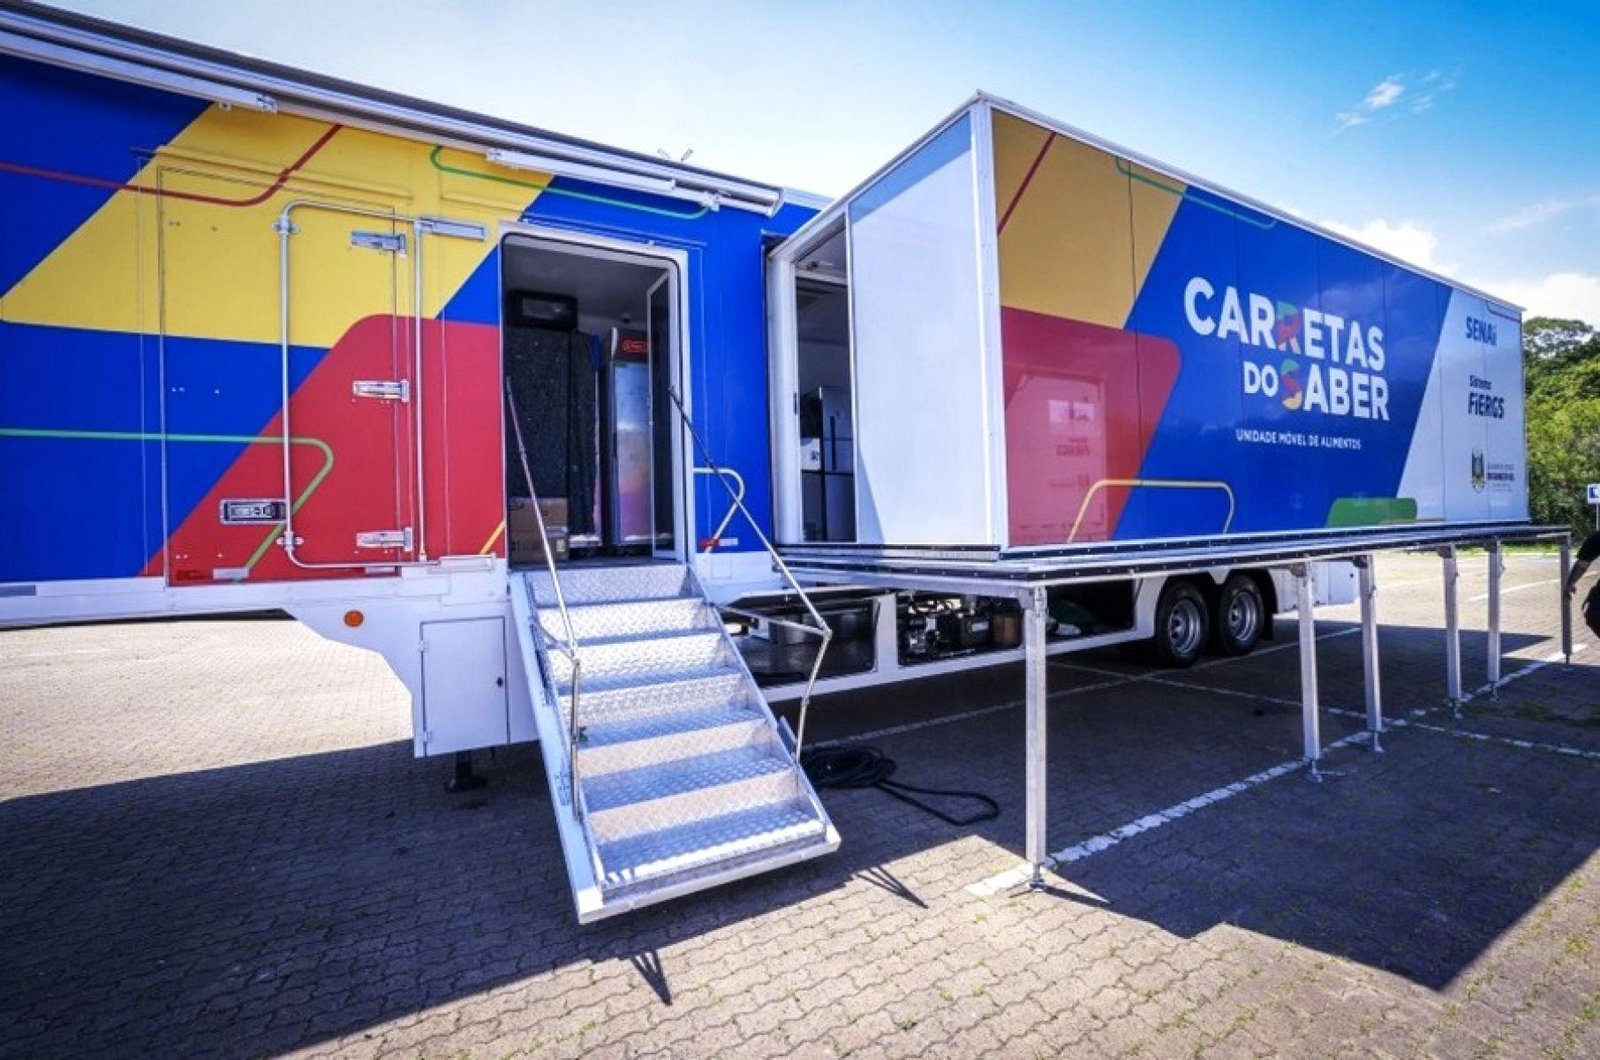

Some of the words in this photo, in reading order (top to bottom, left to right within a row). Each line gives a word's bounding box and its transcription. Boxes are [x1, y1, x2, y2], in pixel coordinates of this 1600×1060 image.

[1184, 276, 1386, 372] CARRETAS
[1243, 360, 1279, 398] DO
[1280, 358, 1390, 421] SABER
[1235, 428, 1277, 444] UNIDADE
[1278, 431, 1307, 447] MÓVEL
[1308, 435, 1319, 447] DE
[1321, 436, 1362, 450] ALIMENTOS
